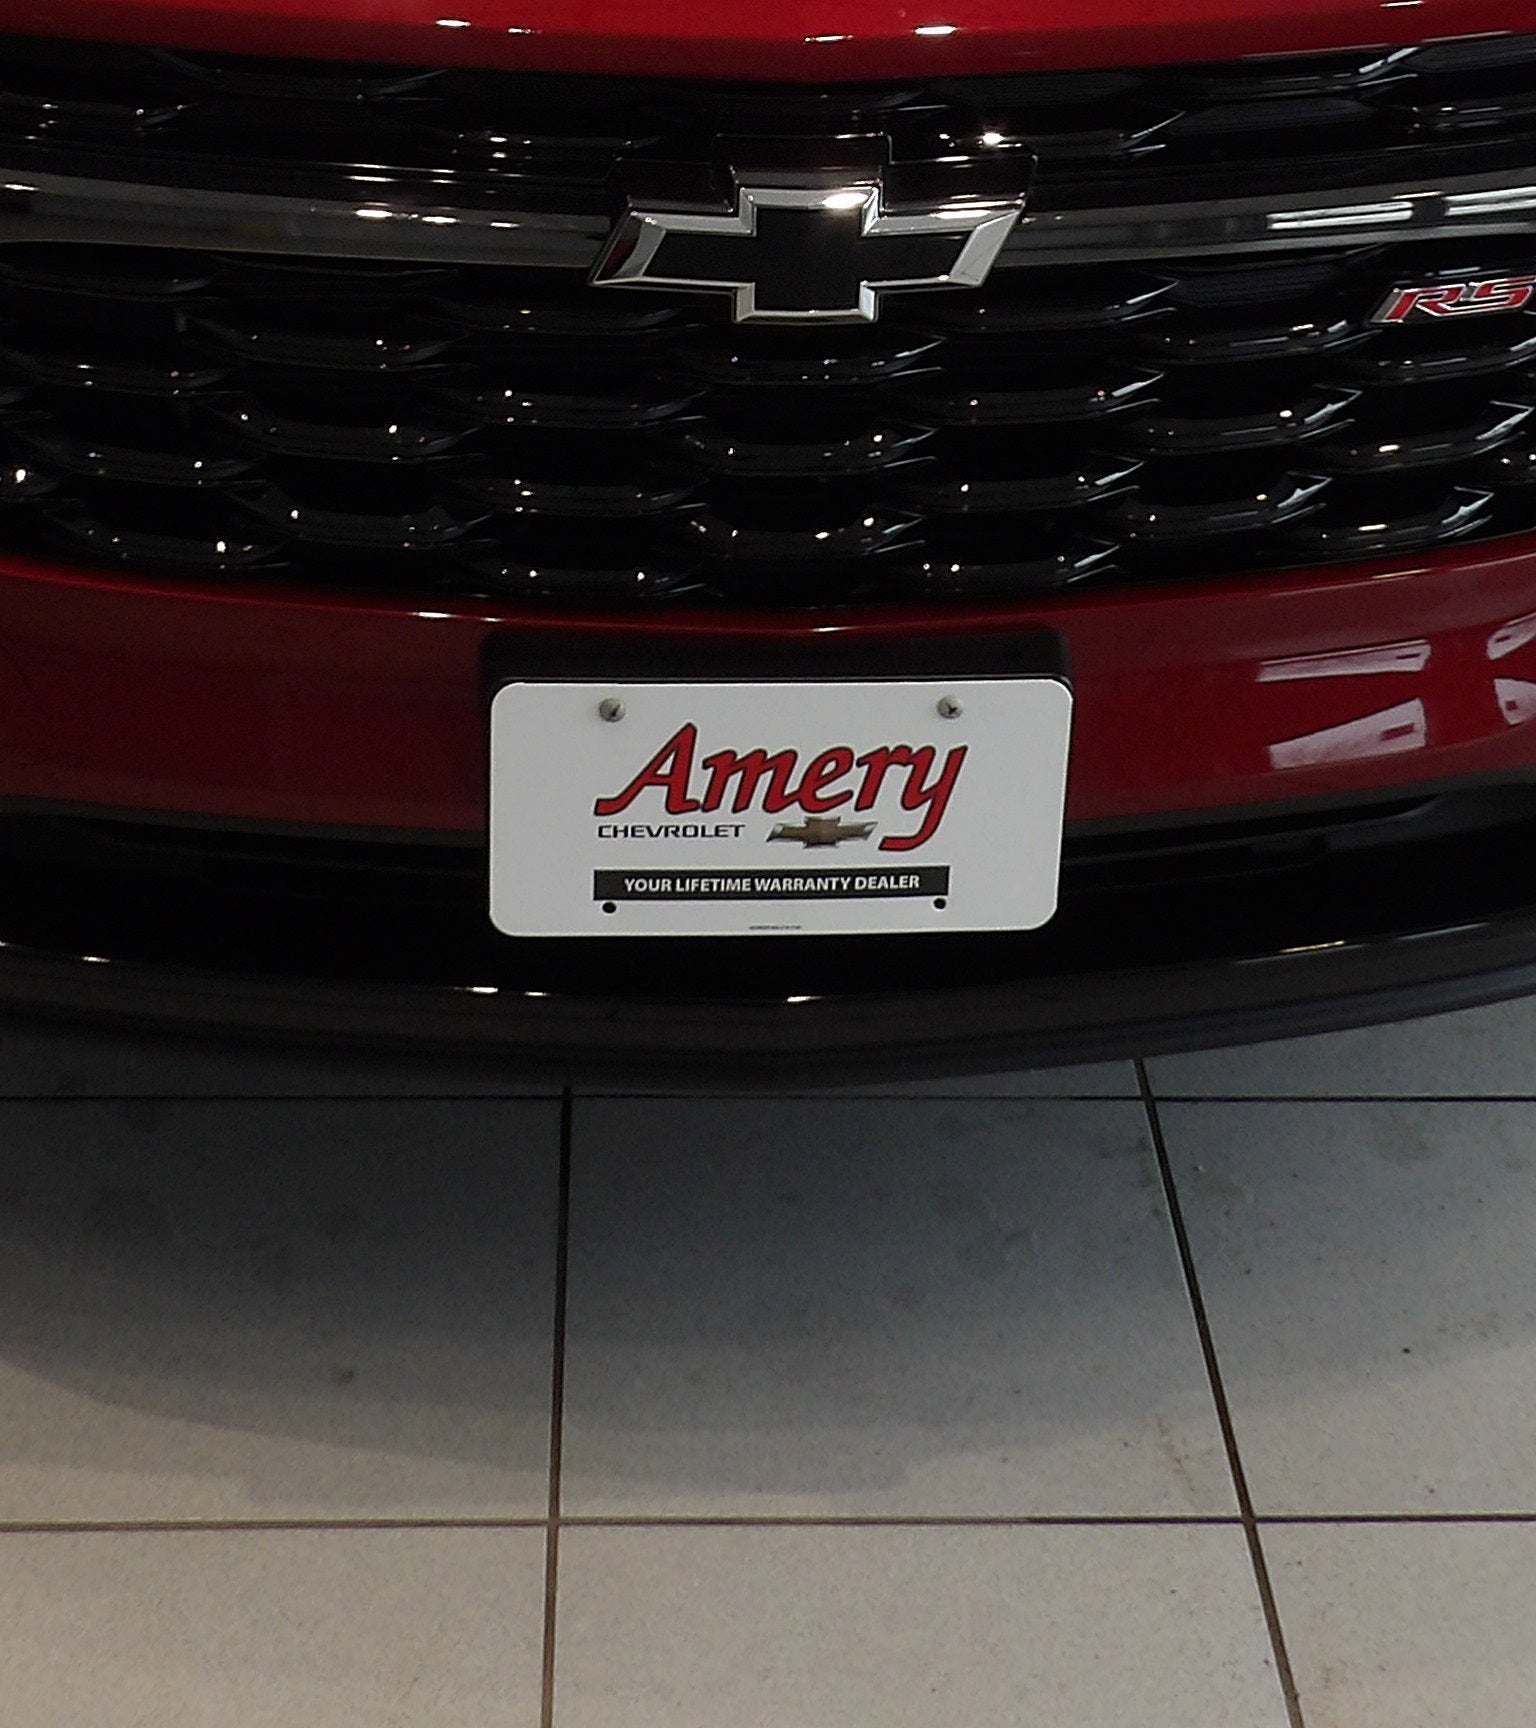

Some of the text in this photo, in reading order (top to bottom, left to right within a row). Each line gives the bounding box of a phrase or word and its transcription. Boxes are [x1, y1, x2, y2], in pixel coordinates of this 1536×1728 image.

[594, 722, 968, 851] Amery
[597, 824, 746, 838] CHEVROLET
[624, 874, 920, 892] YOUR LIFETIME WARRANTY DEALER
